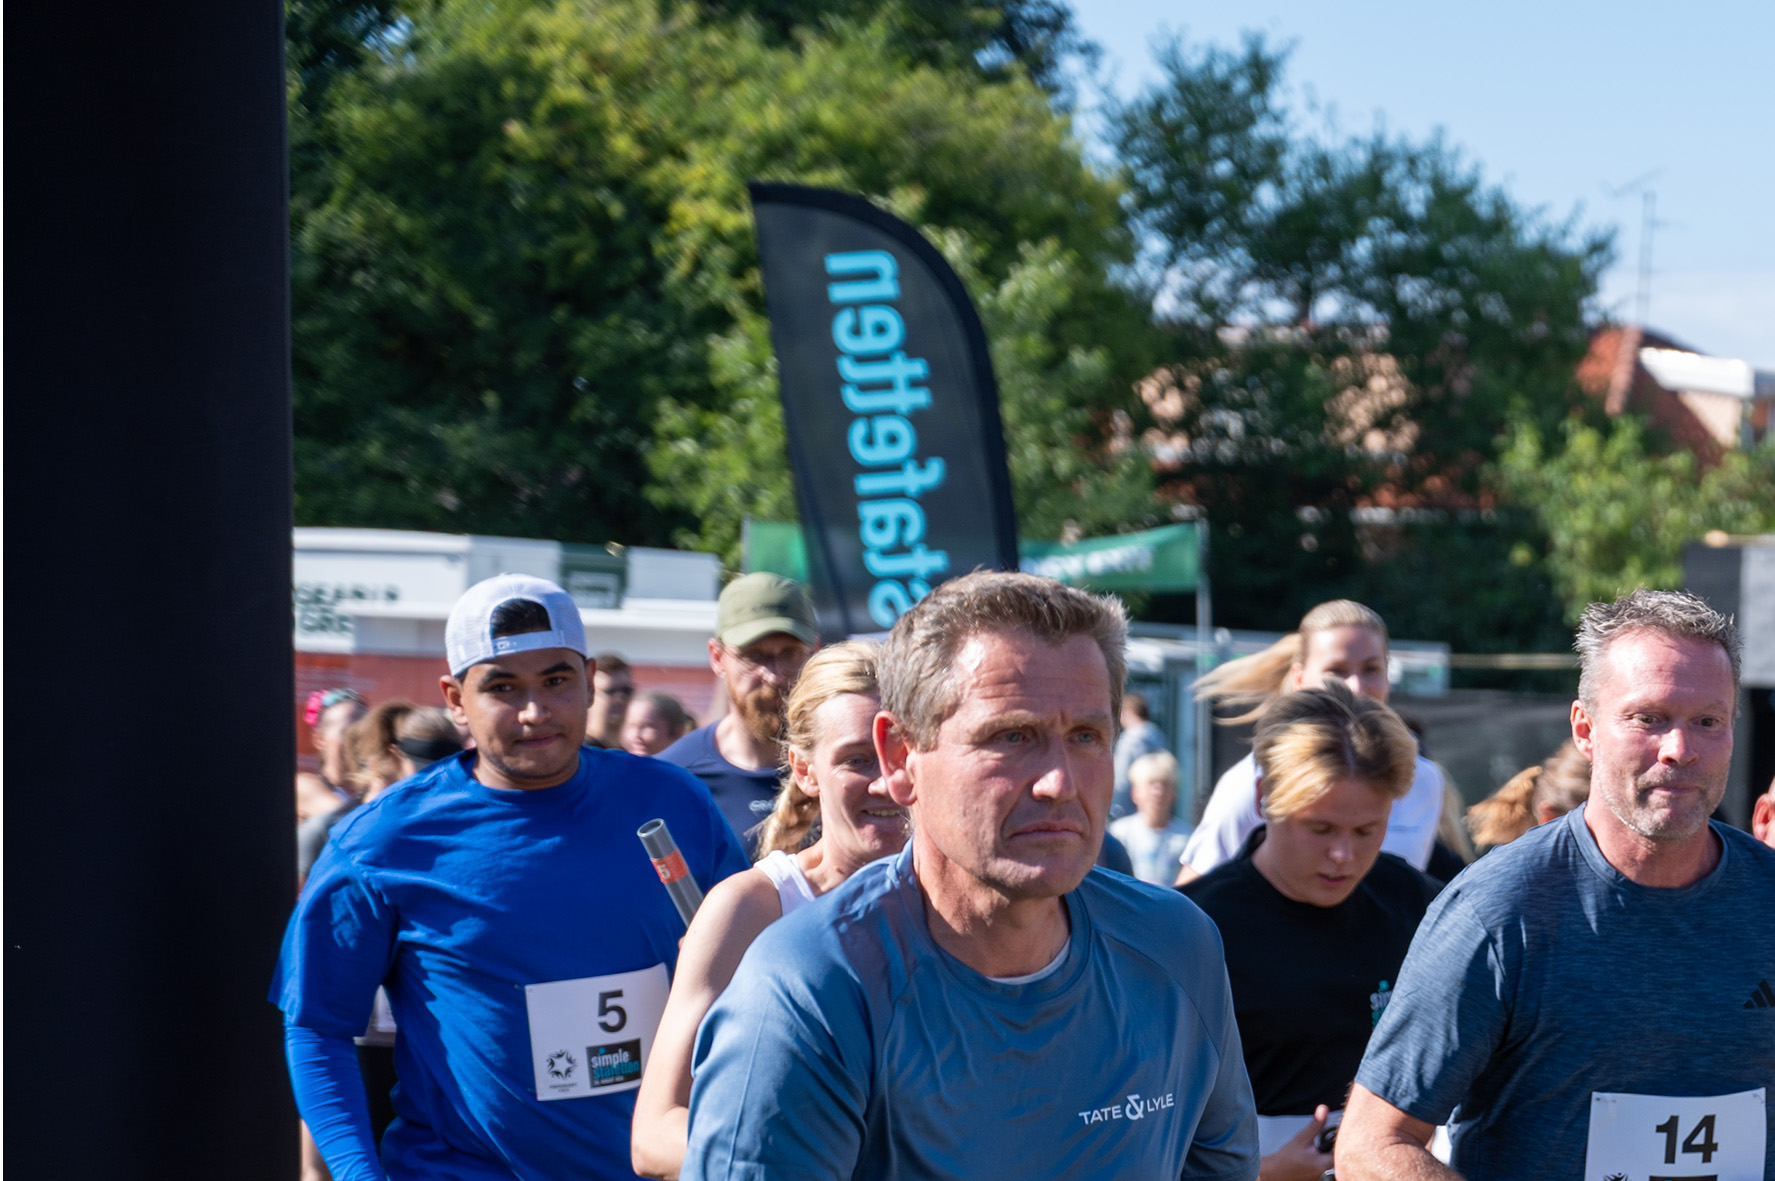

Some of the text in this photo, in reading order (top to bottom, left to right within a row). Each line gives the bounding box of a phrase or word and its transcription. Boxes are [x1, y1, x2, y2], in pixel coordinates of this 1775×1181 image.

[598, 988, 627, 1033] 5
[591, 1047, 631, 1069] simple
[1078, 1093, 1175, 1125] TATE & LYLE
[1655, 1114, 1718, 1164] 14
